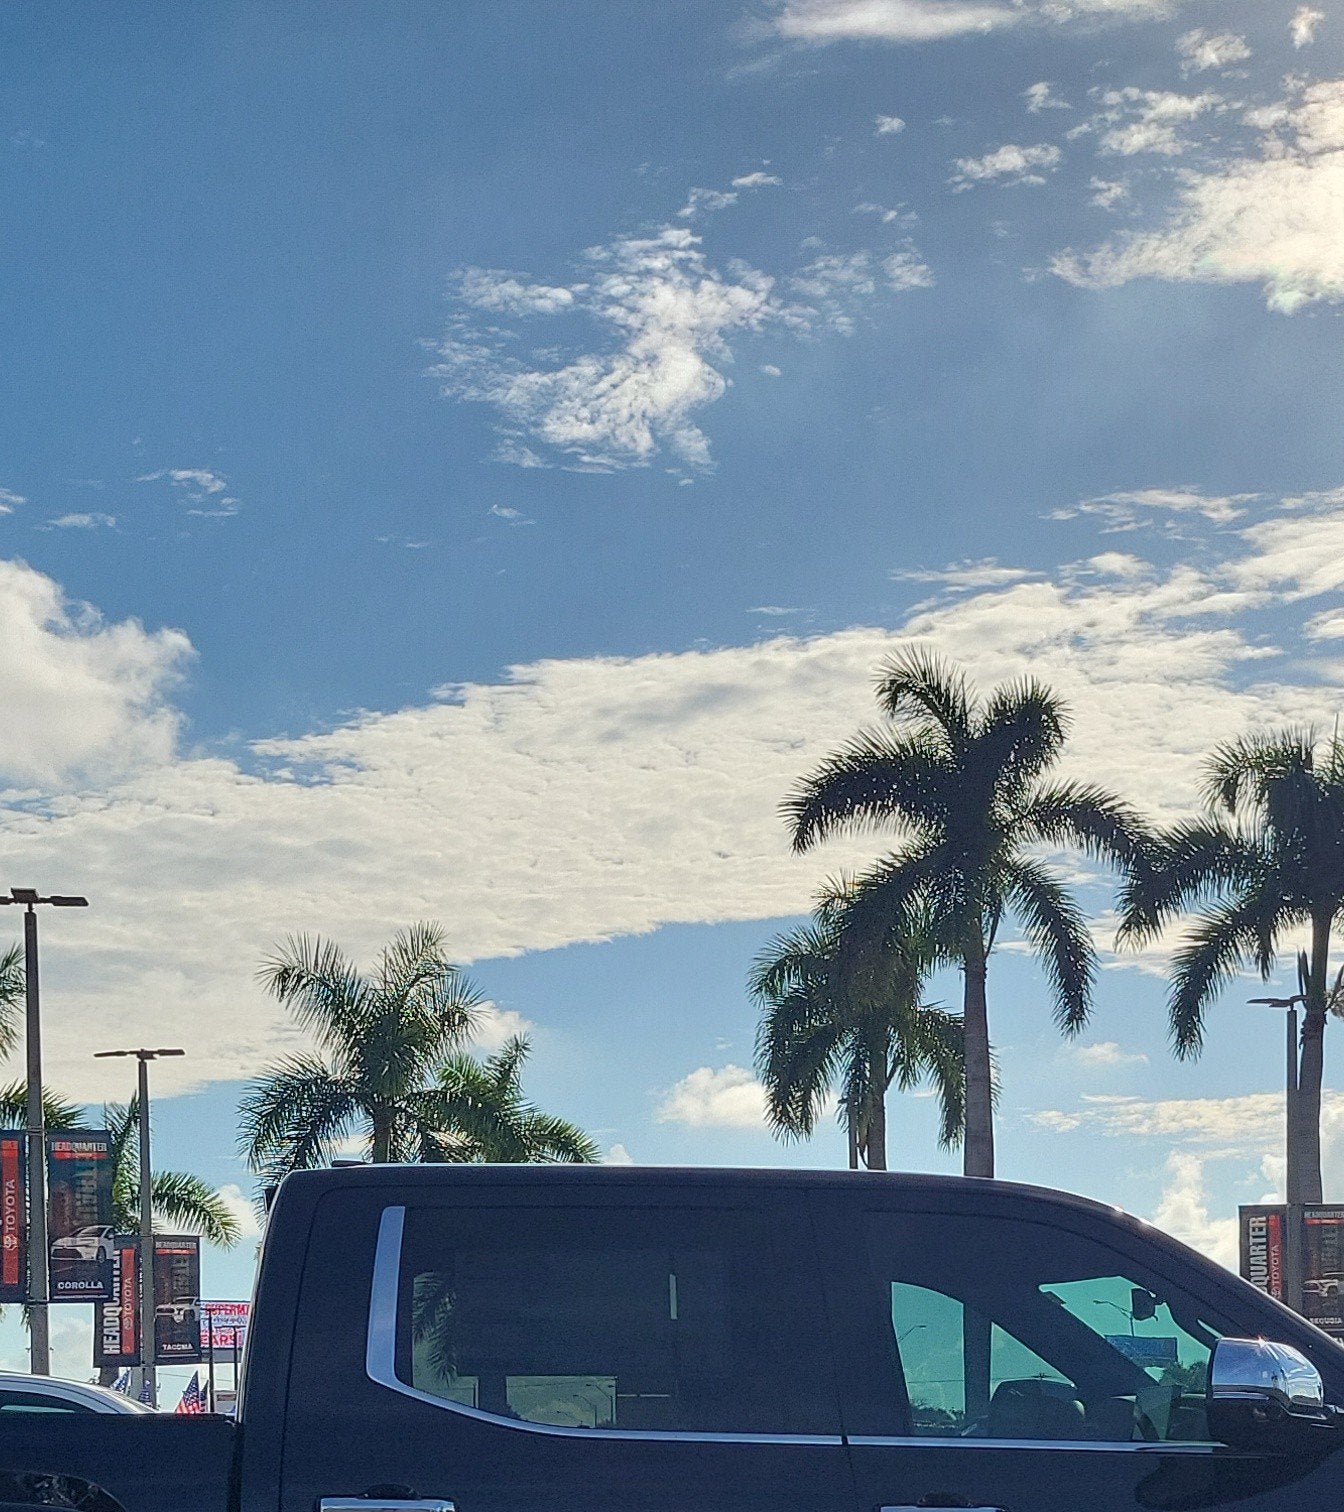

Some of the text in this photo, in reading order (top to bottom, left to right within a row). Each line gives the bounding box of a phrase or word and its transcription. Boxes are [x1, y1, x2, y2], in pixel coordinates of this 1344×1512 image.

[7, 1179, 16, 1232] TOYOTA
[57, 1281, 104, 1289] COROLLA
[1270, 1245, 1280, 1286] TOYOTA
[124, 1278, 132, 1315] TOYOTA
